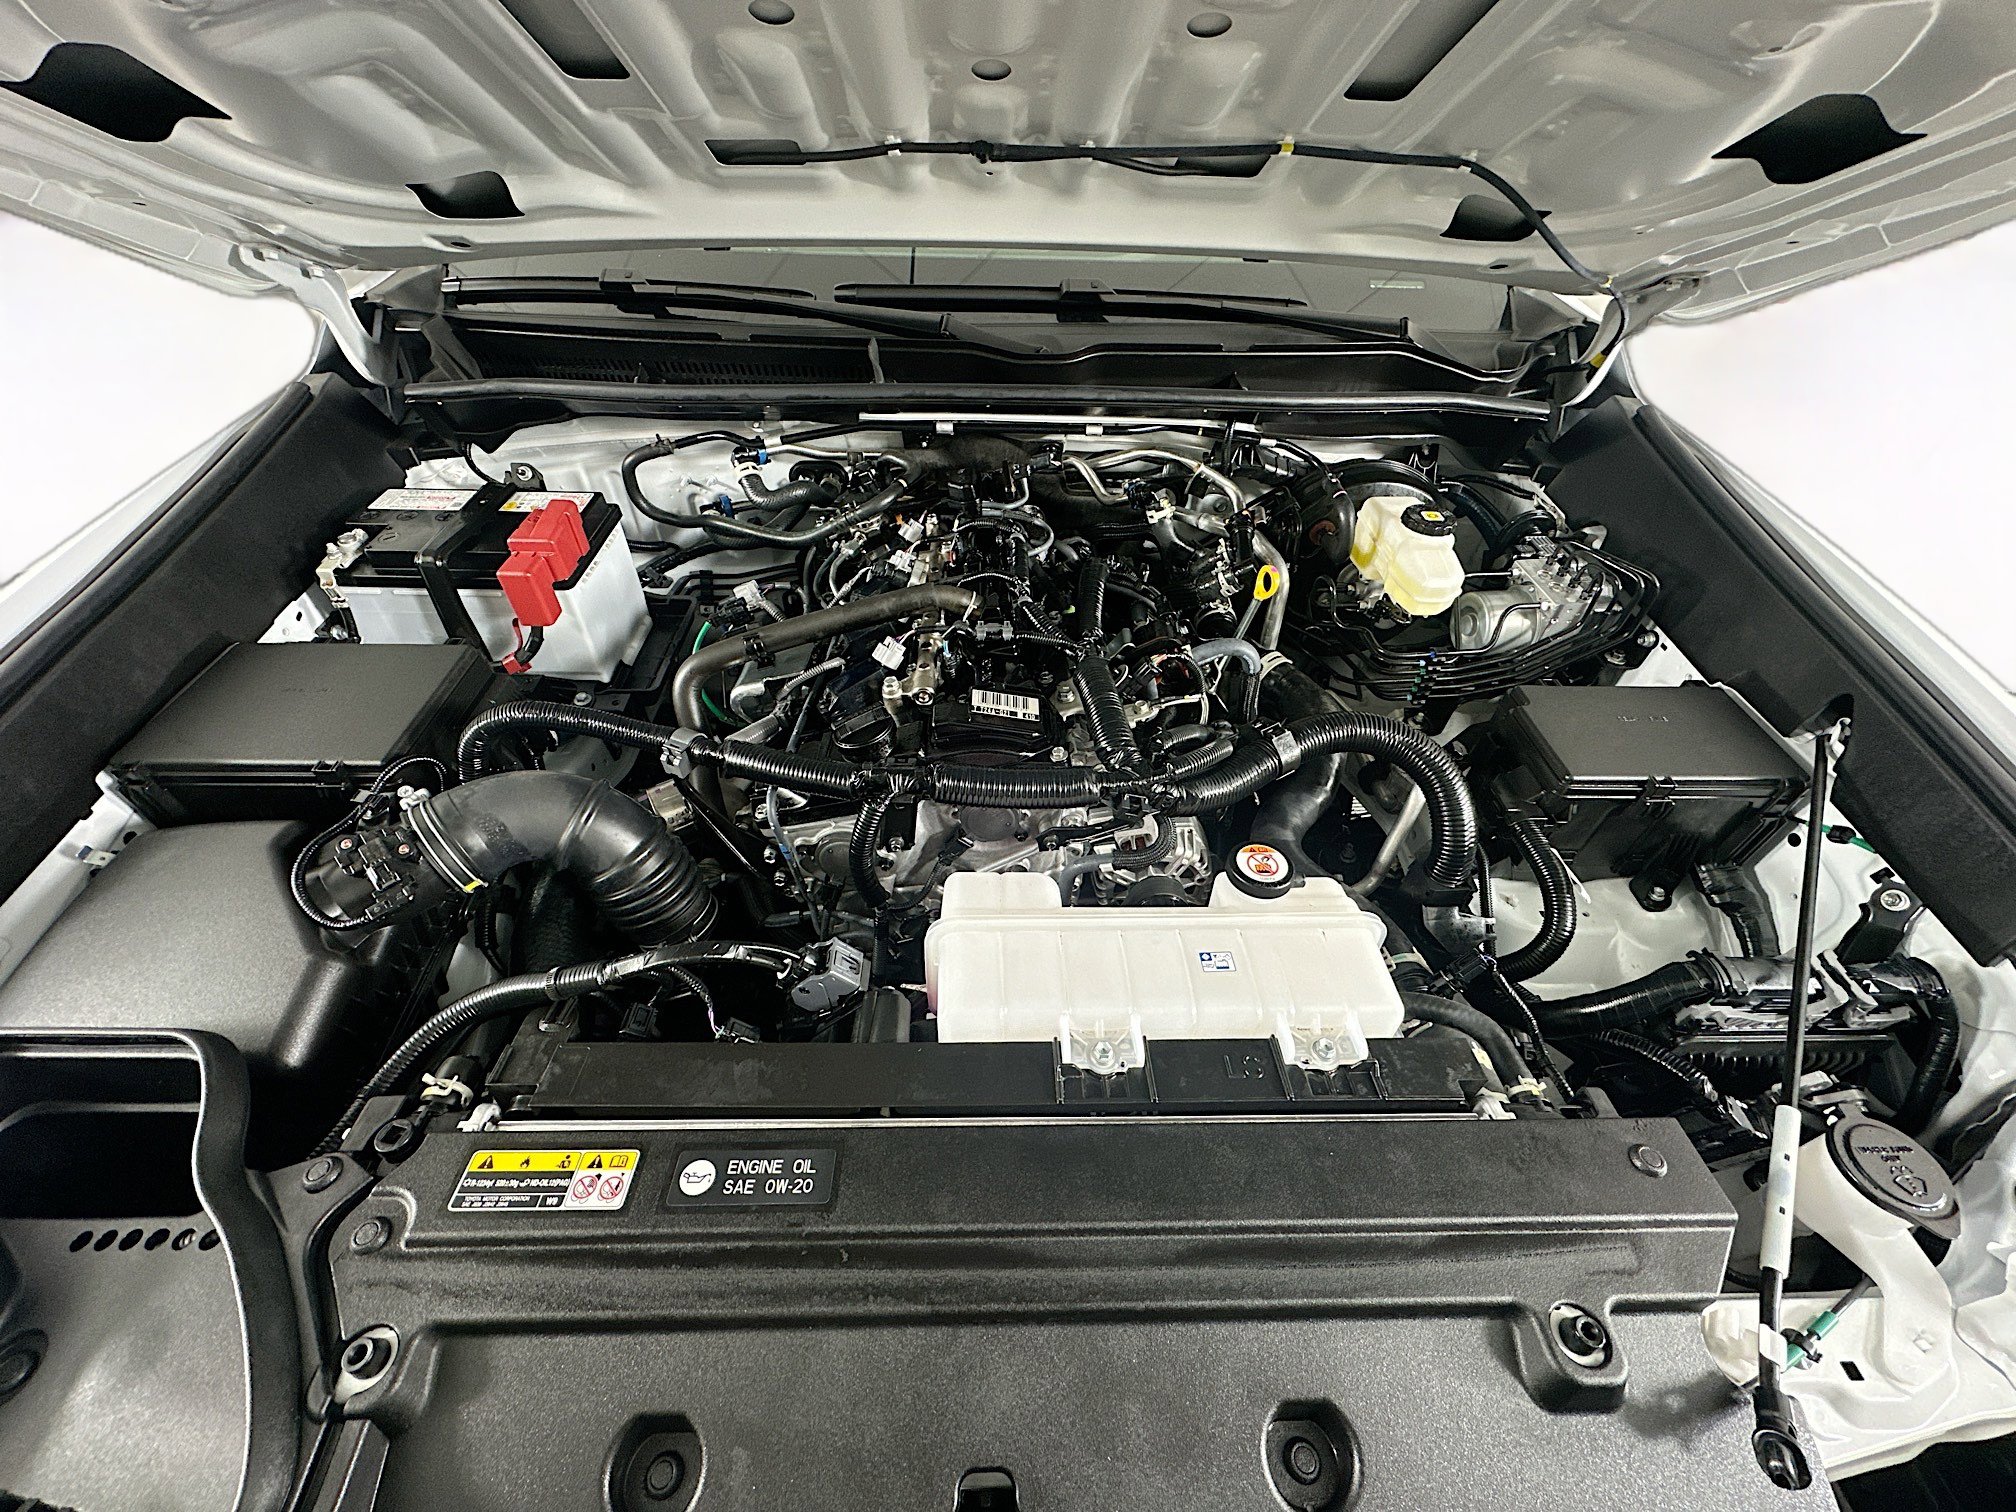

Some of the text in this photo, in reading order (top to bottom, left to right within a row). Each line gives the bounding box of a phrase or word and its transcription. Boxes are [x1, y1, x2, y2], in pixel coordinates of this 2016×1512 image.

[726, 1158, 817, 1175] ENGINE OIL
[722, 1178, 814, 1195] SAE 0W-20
